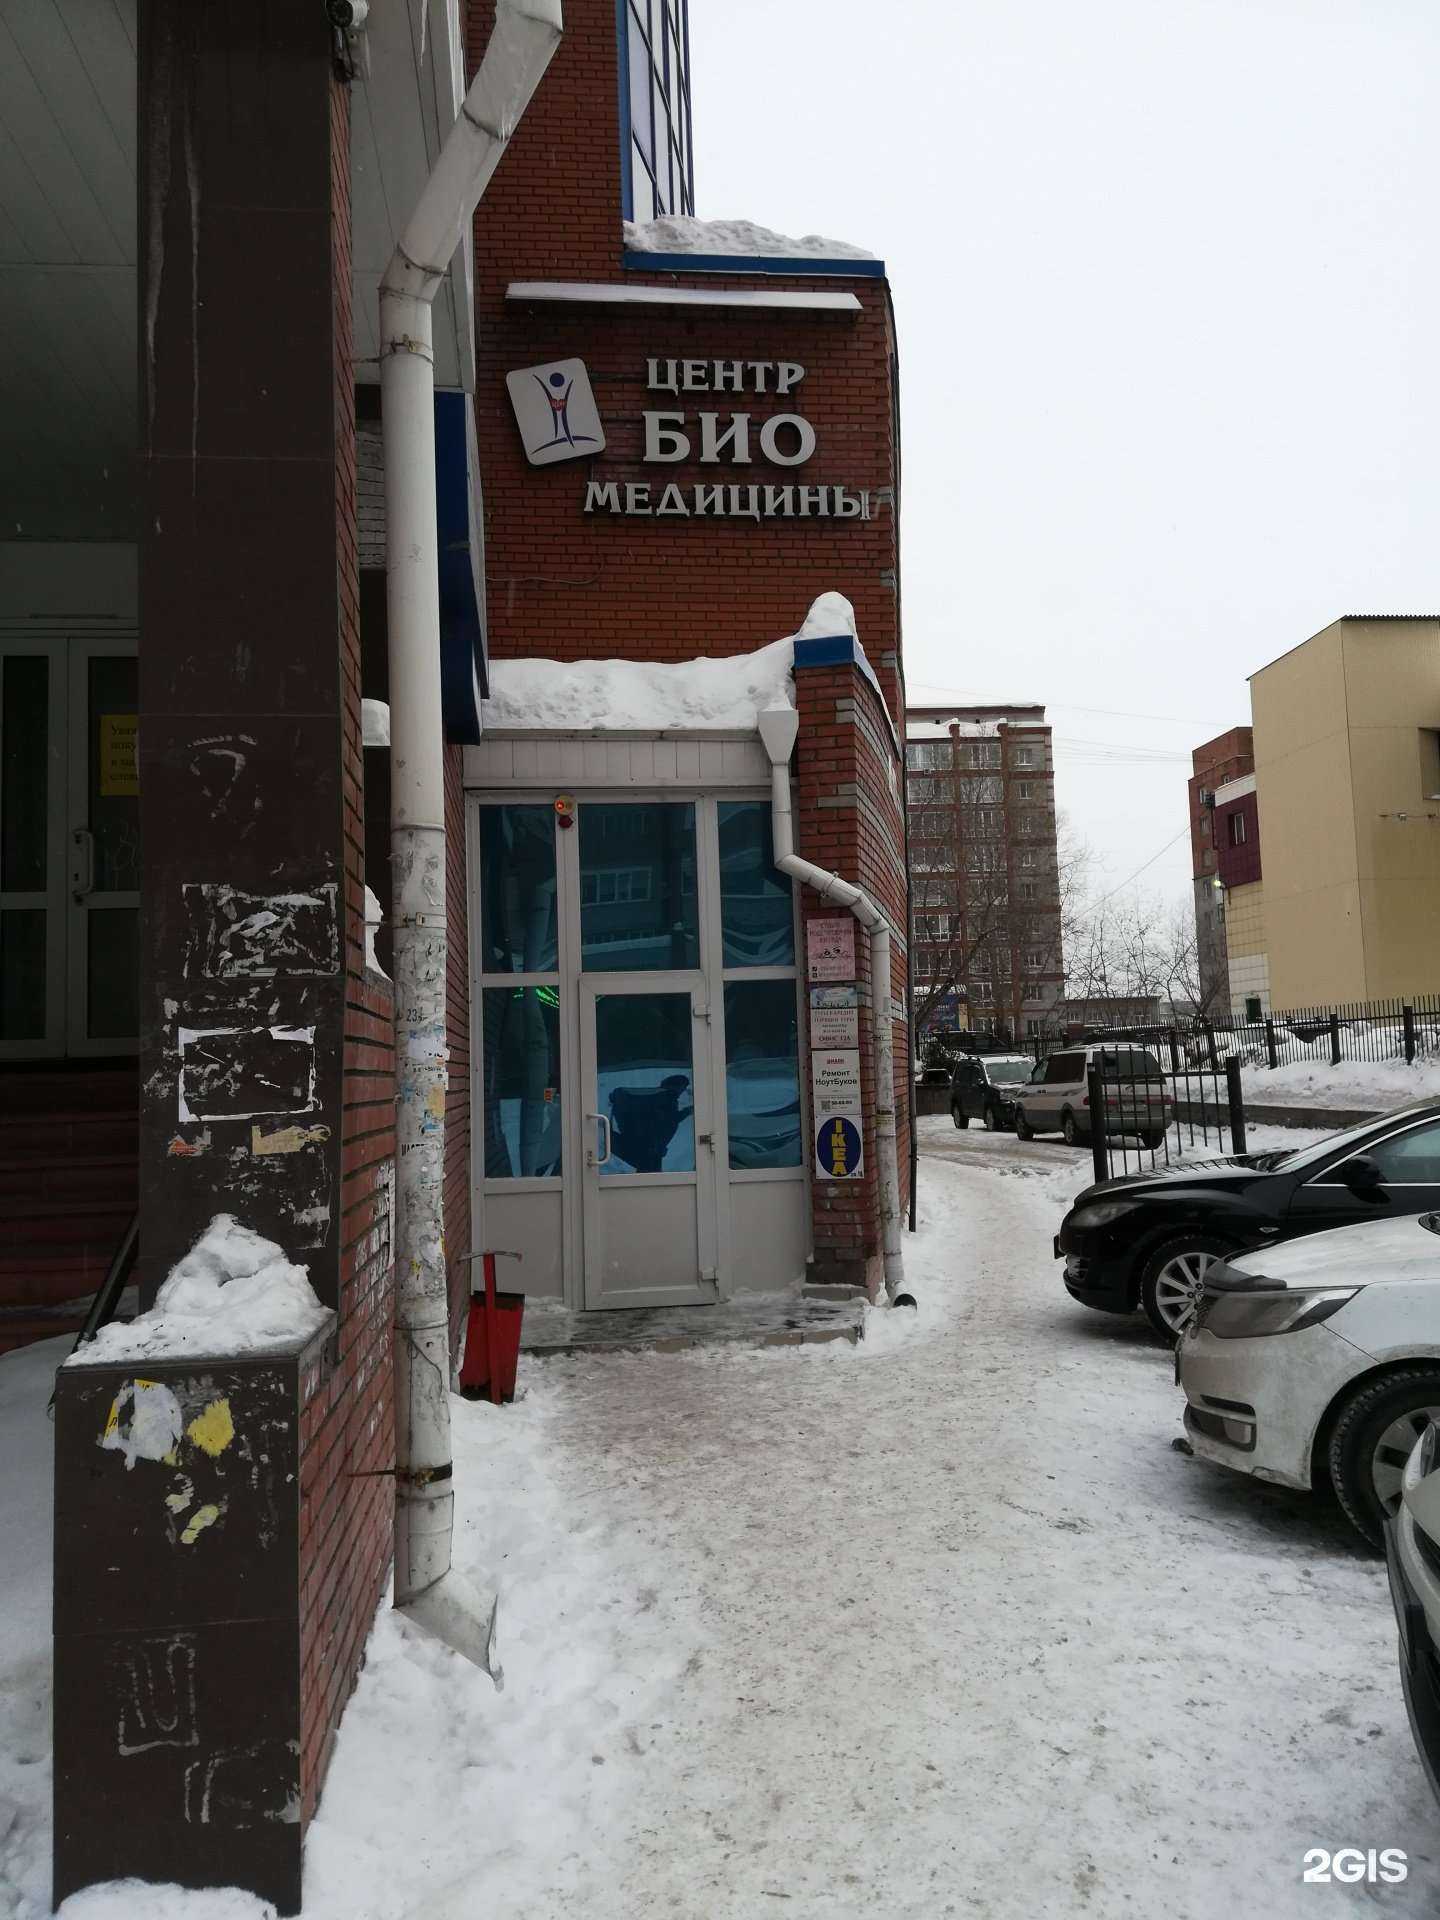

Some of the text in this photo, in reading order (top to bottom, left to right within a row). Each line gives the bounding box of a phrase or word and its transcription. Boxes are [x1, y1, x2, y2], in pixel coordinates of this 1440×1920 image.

[646, 358, 806, 396] ЦЕНТР
[642, 410, 816, 467] БИО
[583, 481, 871, 522] МЕДИЦИНЫ
